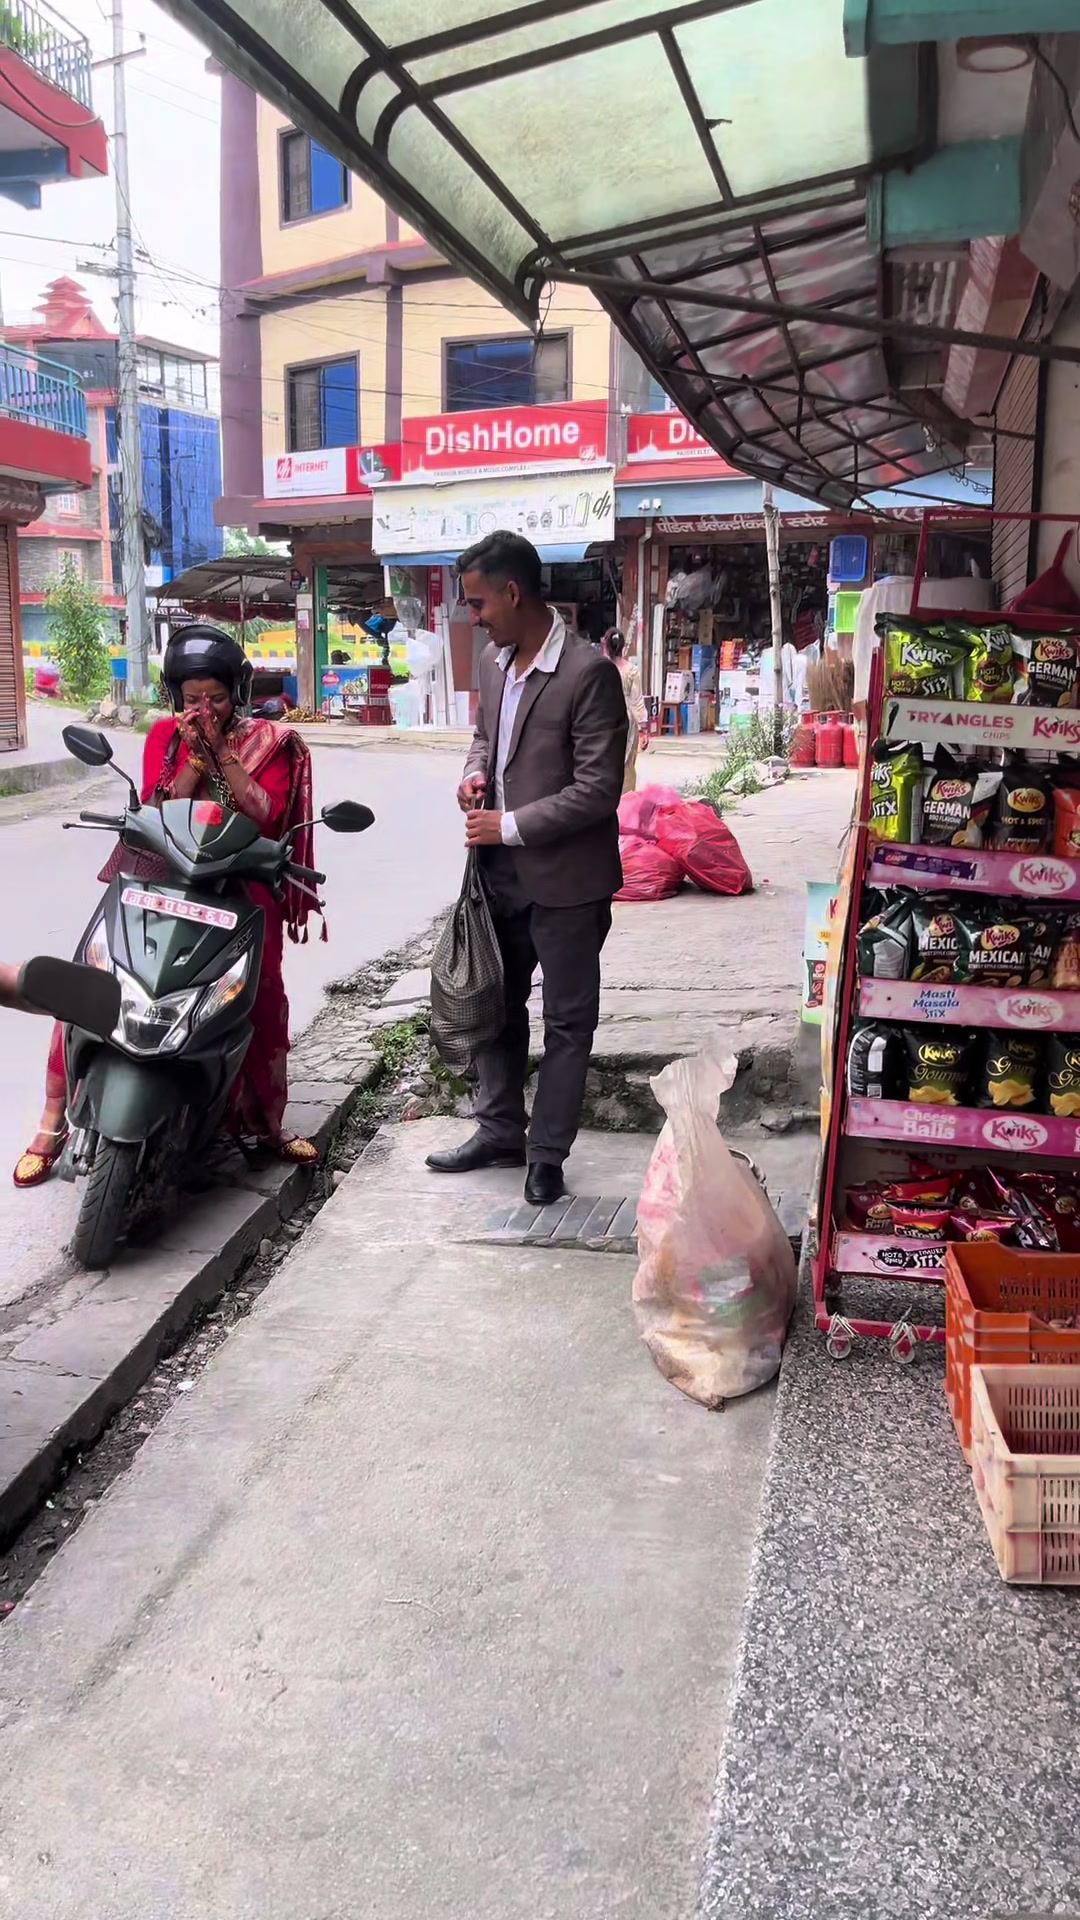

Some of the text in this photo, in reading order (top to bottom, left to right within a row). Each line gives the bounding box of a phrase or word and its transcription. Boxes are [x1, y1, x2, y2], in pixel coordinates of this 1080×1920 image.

[426, 420, 580, 456] DishHome
[295, 461, 329, 473] INTERNET
[901, 642, 952, 666] Kwiks
[1040, 643, 1071, 660] Kwiks
[1027, 661, 1077, 682] GERMAN
[982, 731, 1011, 740] CHIPS
[1032, 715, 1080, 743] Kwiks
[937, 780, 968, 797] Kwiks
[1013, 790, 1042, 809] Kwiks
[924, 801, 971, 819] GERMAN
[1001, 816, 1019, 825] HOT
[1018, 862, 1068, 890] Kwiks
[986, 929, 1016, 947] Kwiks
[969, 950, 1026, 964] MEXICAN
[913, 998, 960, 1008] Masala
[920, 989, 956, 999] Masti
[1007, 998, 1057, 1024] Kwiks
[924, 1044, 957, 1065] Kwiks
[904, 1108, 956, 1124] Cheese
[904, 1120, 956, 1139] Balls
[990, 1120, 1042, 1147] Kwiks
